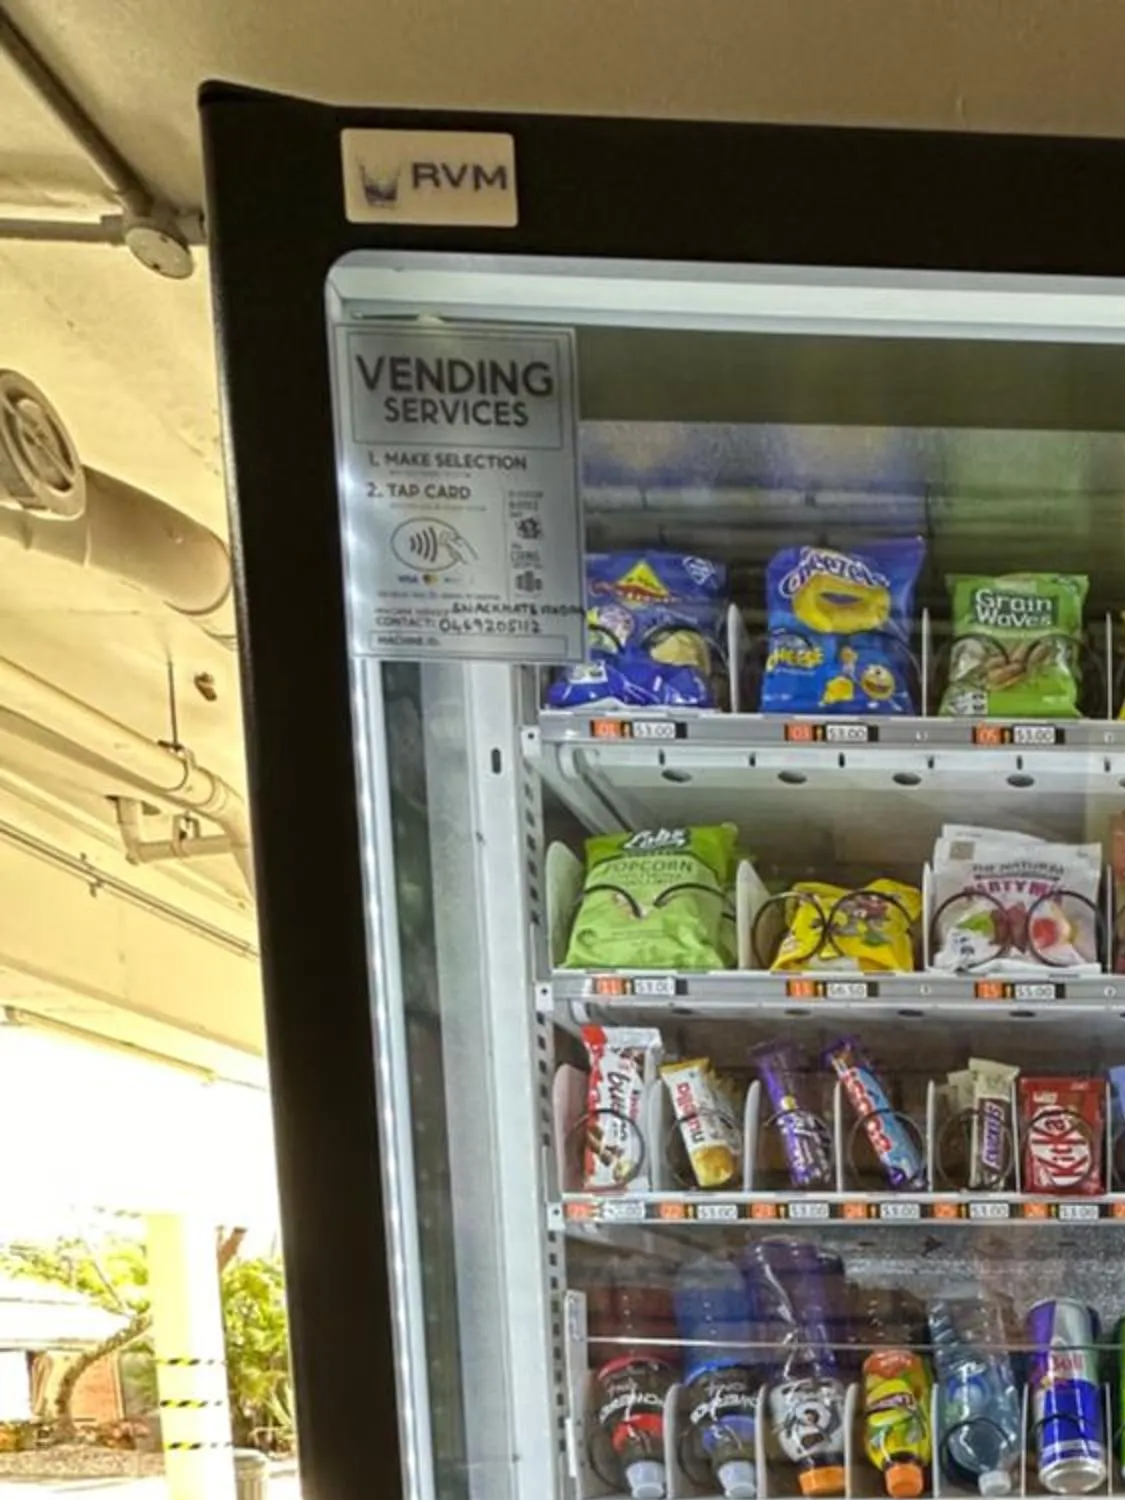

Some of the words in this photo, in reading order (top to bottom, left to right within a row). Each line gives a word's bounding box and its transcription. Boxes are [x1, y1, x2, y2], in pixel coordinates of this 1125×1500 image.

[411, 162, 508, 191] RVM
[356, 354, 554, 397] VENDING
[384, 397, 530, 428] SERVICES
[385, 452, 431, 468] MAKE
[434, 453, 528, 471] SELECTION
[388, 483, 420, 498] TAP
[424, 484, 471, 500] CARD
[976, 588, 1052, 613] Grain
[975, 603, 1053, 627] Waves
[635, 722, 673, 738] $3.00
[605, 860, 693, 873] POPCORN
